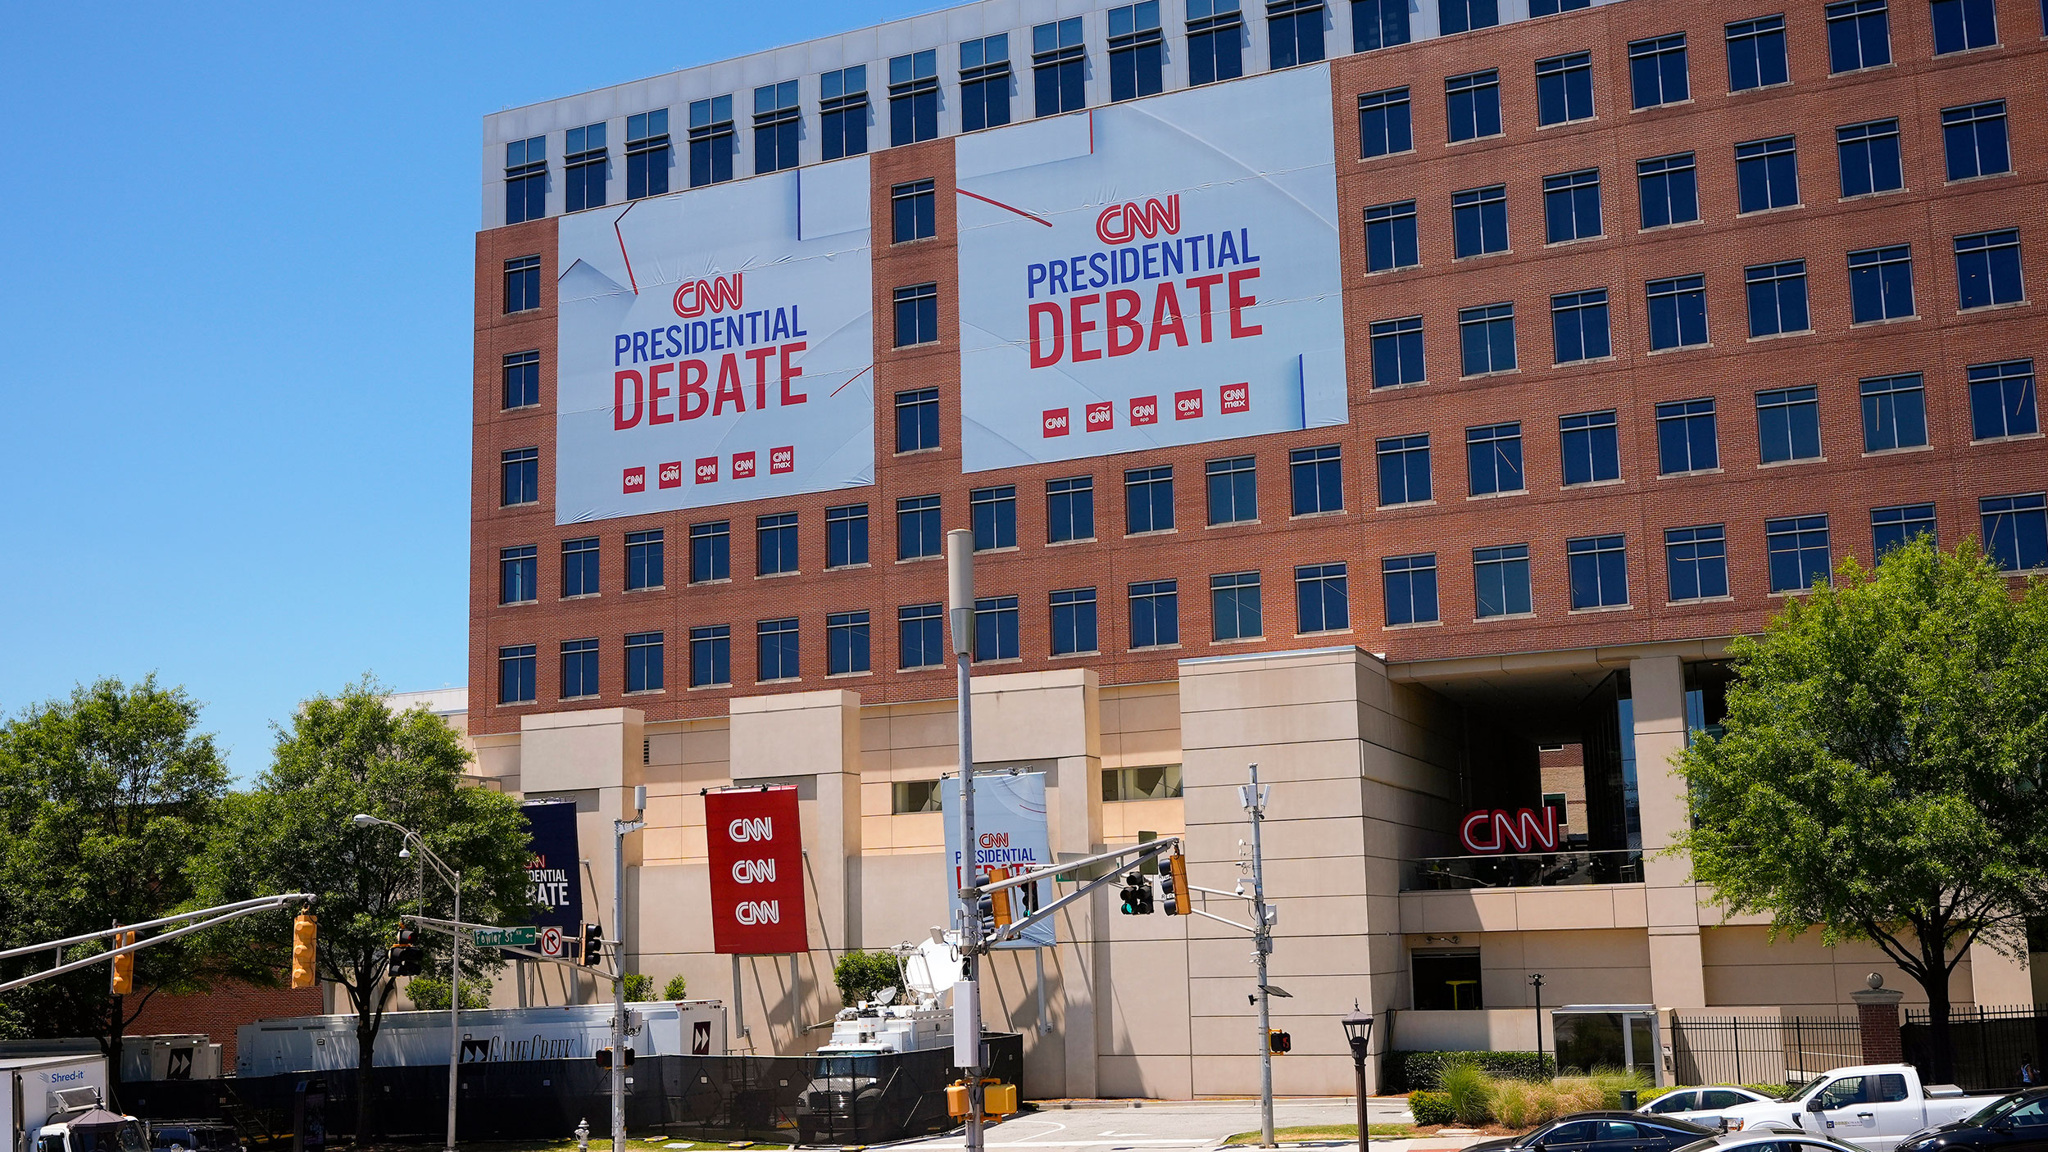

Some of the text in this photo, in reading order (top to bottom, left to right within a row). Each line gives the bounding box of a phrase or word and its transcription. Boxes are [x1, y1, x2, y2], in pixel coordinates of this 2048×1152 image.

[1096, 194, 1180, 245] CNN
[1028, 228, 1260, 299] PRESIDENTIAL
[673, 273, 743, 318] CNN
[1028, 267, 1263, 369] DEBATE
[615, 305, 807, 366] PRESIDENTIAL
[614, 341, 807, 431] DEBATE
[1223, 388, 1246, 401] CNN
[1132, 404, 1155, 418] CNN
[1177, 398, 1200, 412] CNN
[1224, 400, 1246, 409] max
[1045, 416, 1067, 430] CNN
[772, 450, 791, 463] CNN
[697, 464, 717, 477] CNN
[734, 459, 754, 472] CNN
[773, 461, 791, 470] max
[625, 474, 643, 487] CNN
[728, 817, 773, 842] CNN
[1460, 806, 1558, 854] CNN
[978, 832, 1009, 848] CNN
[955, 848, 1037, 864] PSIDENTIAL
[528, 869, 568, 882] DENTIAL
[732, 858, 777, 884] CNN
[735, 900, 780, 925] CNN
[51, 1070, 84, 1083] Shred-it
